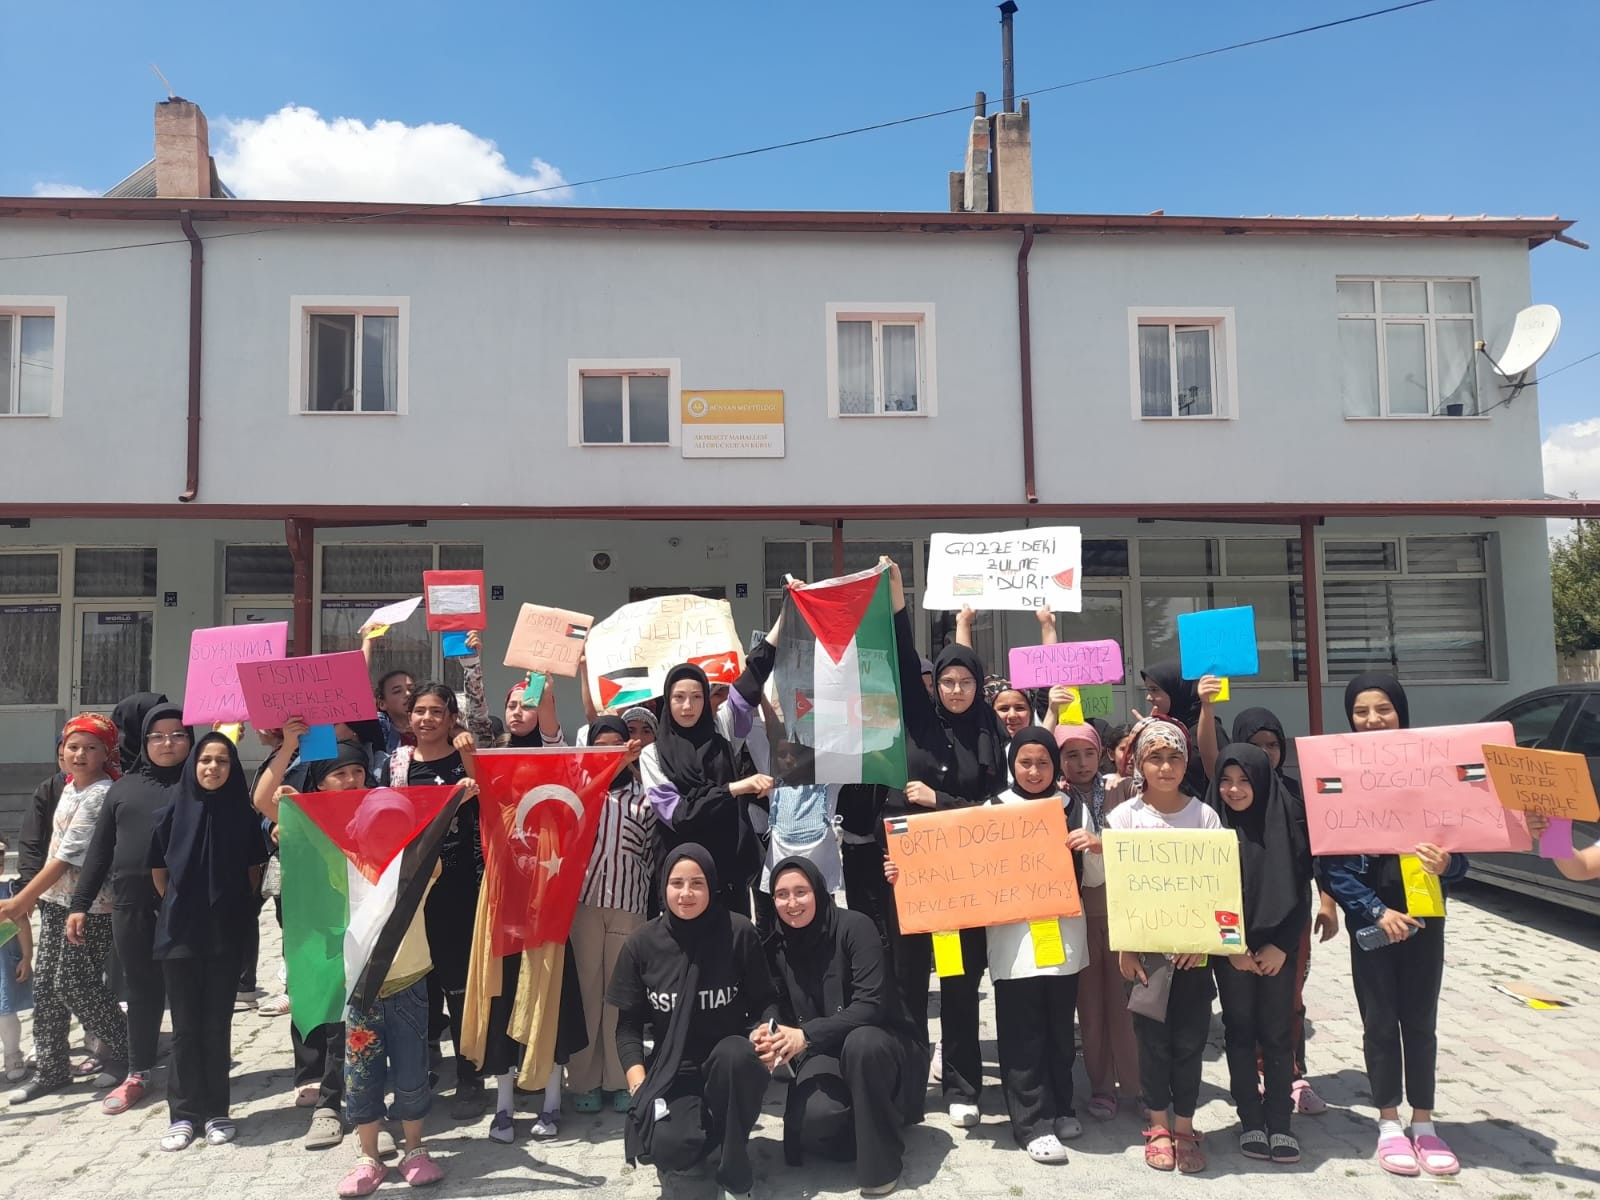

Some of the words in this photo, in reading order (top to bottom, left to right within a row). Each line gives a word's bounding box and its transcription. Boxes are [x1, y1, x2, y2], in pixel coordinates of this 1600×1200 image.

[986, 558, 1039, 572] ZULME
[1332, 738, 1450, 766] FİLİSTİN
[1360, 766, 1453, 791] ÖZGÜR
[1325, 808, 1405, 830] OLANA
[900, 828, 948, 856] ORTA
[1020, 852, 1053, 873] BİR
[906, 894, 981, 915] DEVLETE
[987, 886, 1021, 905] YER
